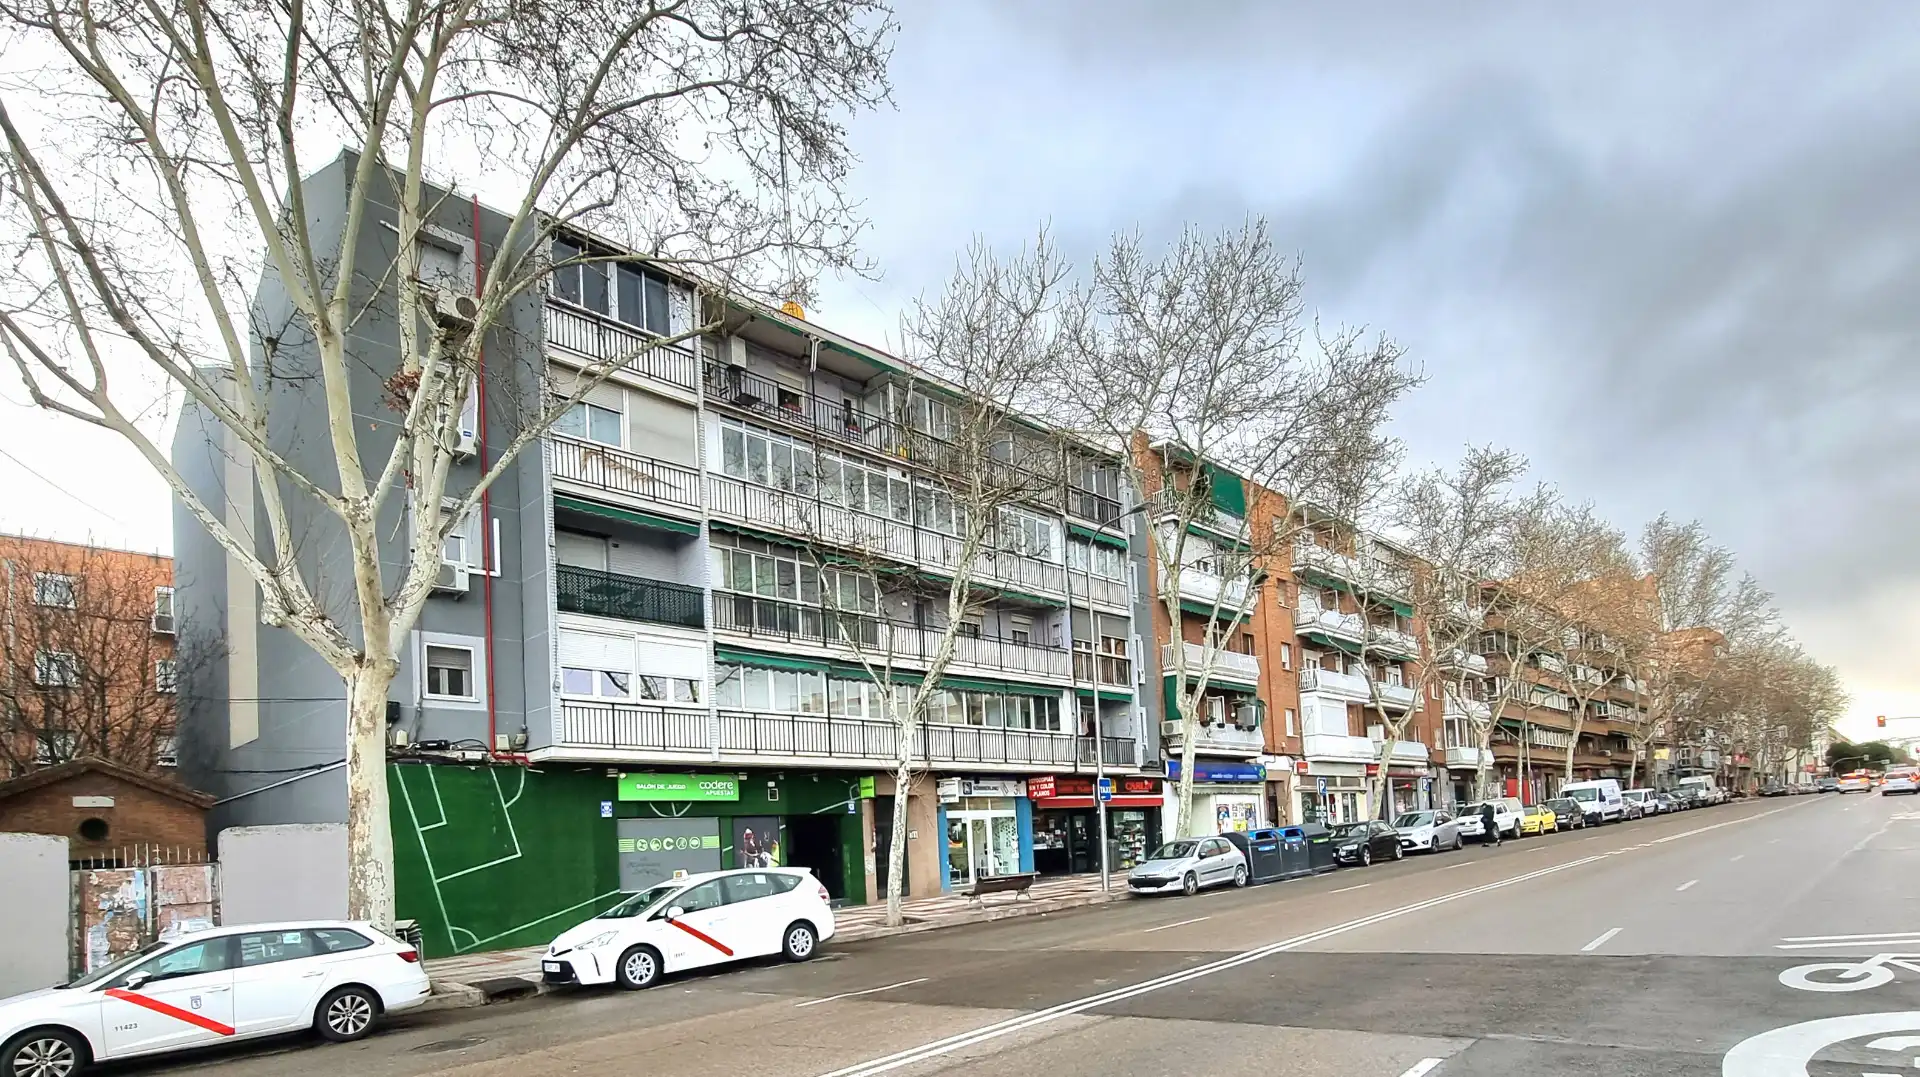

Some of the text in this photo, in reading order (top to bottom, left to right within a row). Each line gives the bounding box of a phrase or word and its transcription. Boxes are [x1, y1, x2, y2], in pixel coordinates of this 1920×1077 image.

[699, 780, 733, 790] codere
[1040, 782, 1054, 790] COLOR
[1099, 786, 1110, 794] TAXI
[114, 1023, 138, 1031] 11423
